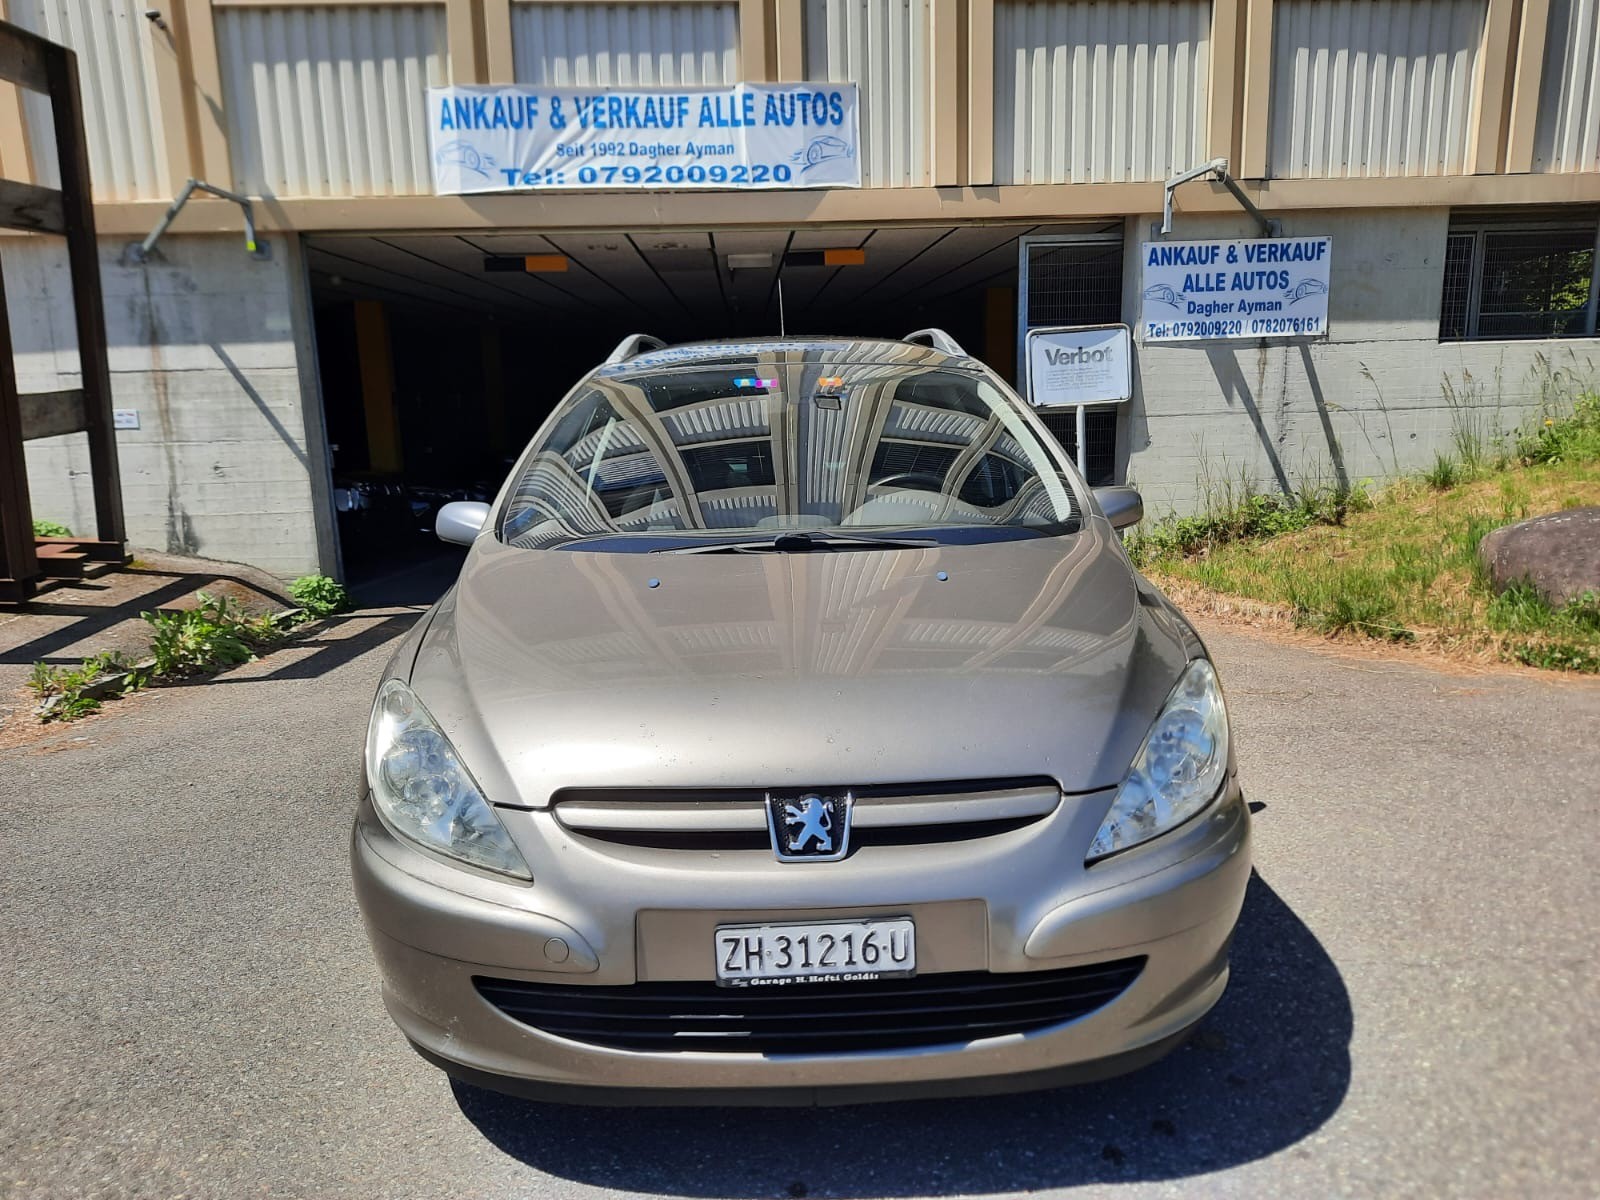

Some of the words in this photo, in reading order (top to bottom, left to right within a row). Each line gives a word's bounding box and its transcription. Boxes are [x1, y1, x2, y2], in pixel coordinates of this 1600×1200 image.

[440, 96, 539, 131] ANKAUF
[549, 97, 566, 130] &
[574, 96, 690, 129] VERKAUF
[698, 94, 756, 128] ALLE
[763, 91, 845, 127] AUTOS
[555, 142, 588, 158] Seit
[592, 142, 625, 156] 1992
[629, 142, 682, 160] Dagher
[685, 141, 736, 159] Ayman
[500, 167, 564, 186] Tel:
[578, 163, 792, 184] 0792009220
[1148, 245, 1220, 266] ANKAUF
[1226, 244, 1239, 264] &
[1244, 241, 1327, 263] VERKAUF
[1182, 272, 1226, 293] ALLE
[1231, 269, 1290, 291] AUTOS
[1187, 300, 1235, 317] Dagher
[1237, 299, 1282, 315] Ayman
[1148, 323, 1169, 338] Tel:
[1172, 320, 1243, 337] 0792009220
[1251, 317, 1320, 334] 0782076161
[1044, 346, 1113, 366] Verbot
[750, 977, 792, 986] Garage
